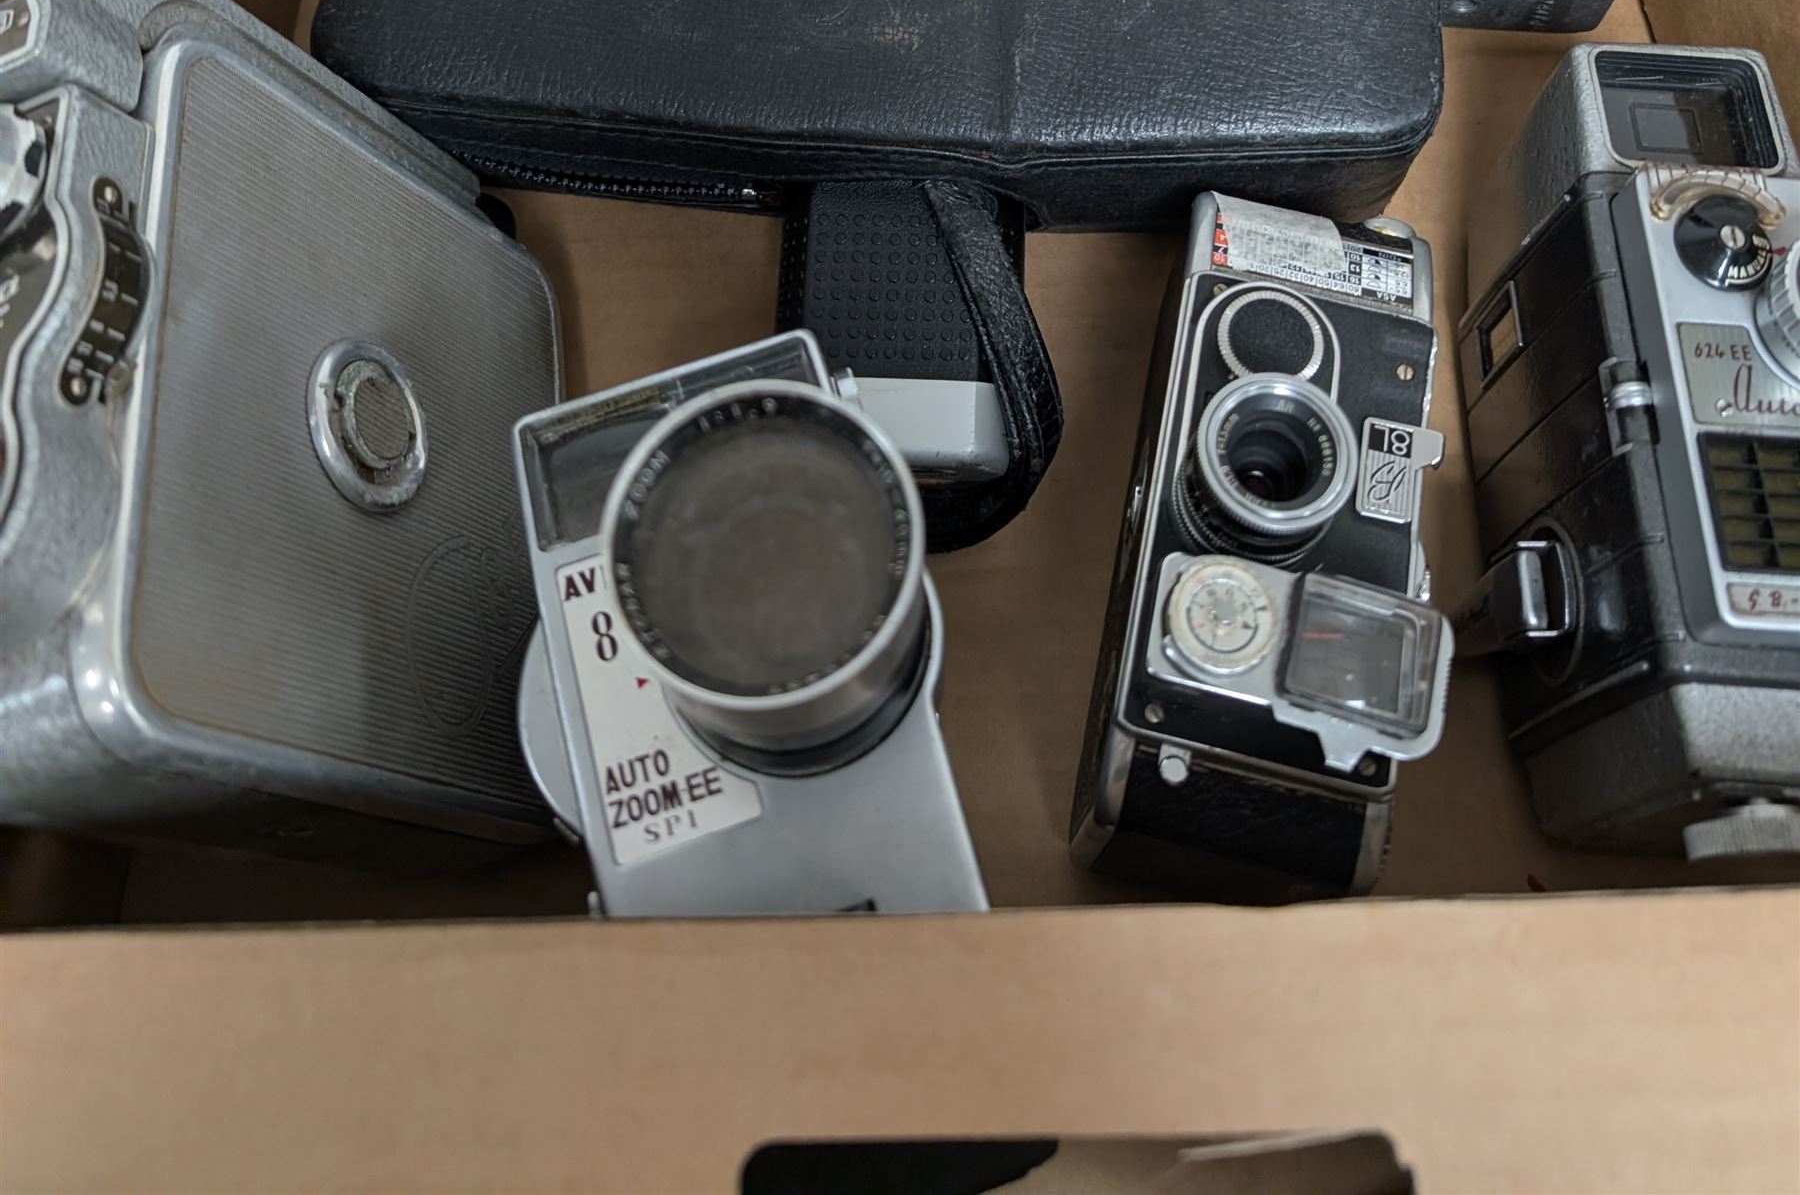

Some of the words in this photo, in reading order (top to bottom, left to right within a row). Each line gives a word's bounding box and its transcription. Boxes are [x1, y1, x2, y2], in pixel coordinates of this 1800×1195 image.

[1727, 250, 1767, 279] MANUAL
[1694, 341, 1725, 359] 624
[1729, 344, 1753, 362] EE
[1373, 424, 1411, 456] 8L
[591, 610, 619, 663] 8
[605, 748, 670, 795] AUTO
[608, 779, 684, 829] ZOOM
[685, 765, 724, 803] EE
